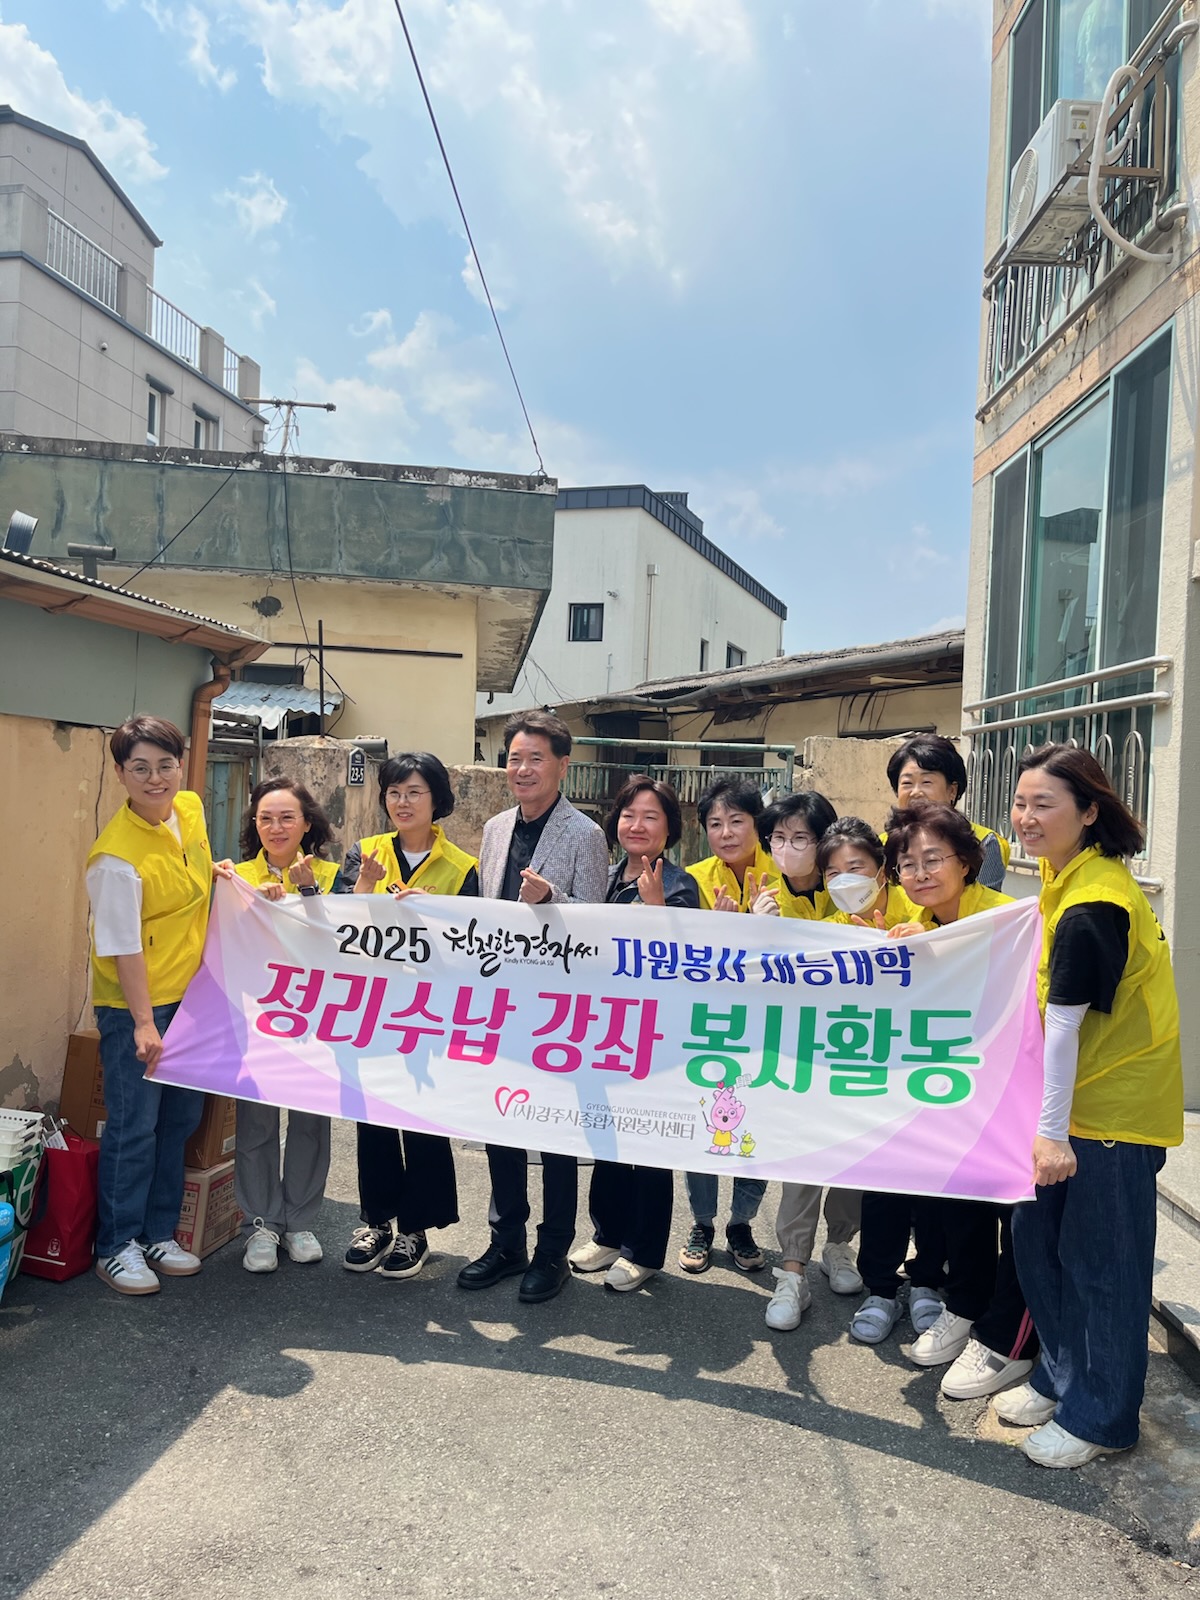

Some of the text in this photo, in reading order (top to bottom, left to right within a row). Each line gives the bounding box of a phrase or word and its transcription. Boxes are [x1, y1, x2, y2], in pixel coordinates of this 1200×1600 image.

[351, 767, 364, 781] 23-5
[336, 924, 431, 963] 2025
[611, 937, 747, 984] 자원봉사
[761, 944, 915, 987] 재능대학
[504, 957, 518, 965] Kindly
[255, 962, 981, 1105] 정리수납 강좌 봉사활동
[586, 1102, 697, 1122] GYEONGJU VOLUNTEER CENTER
